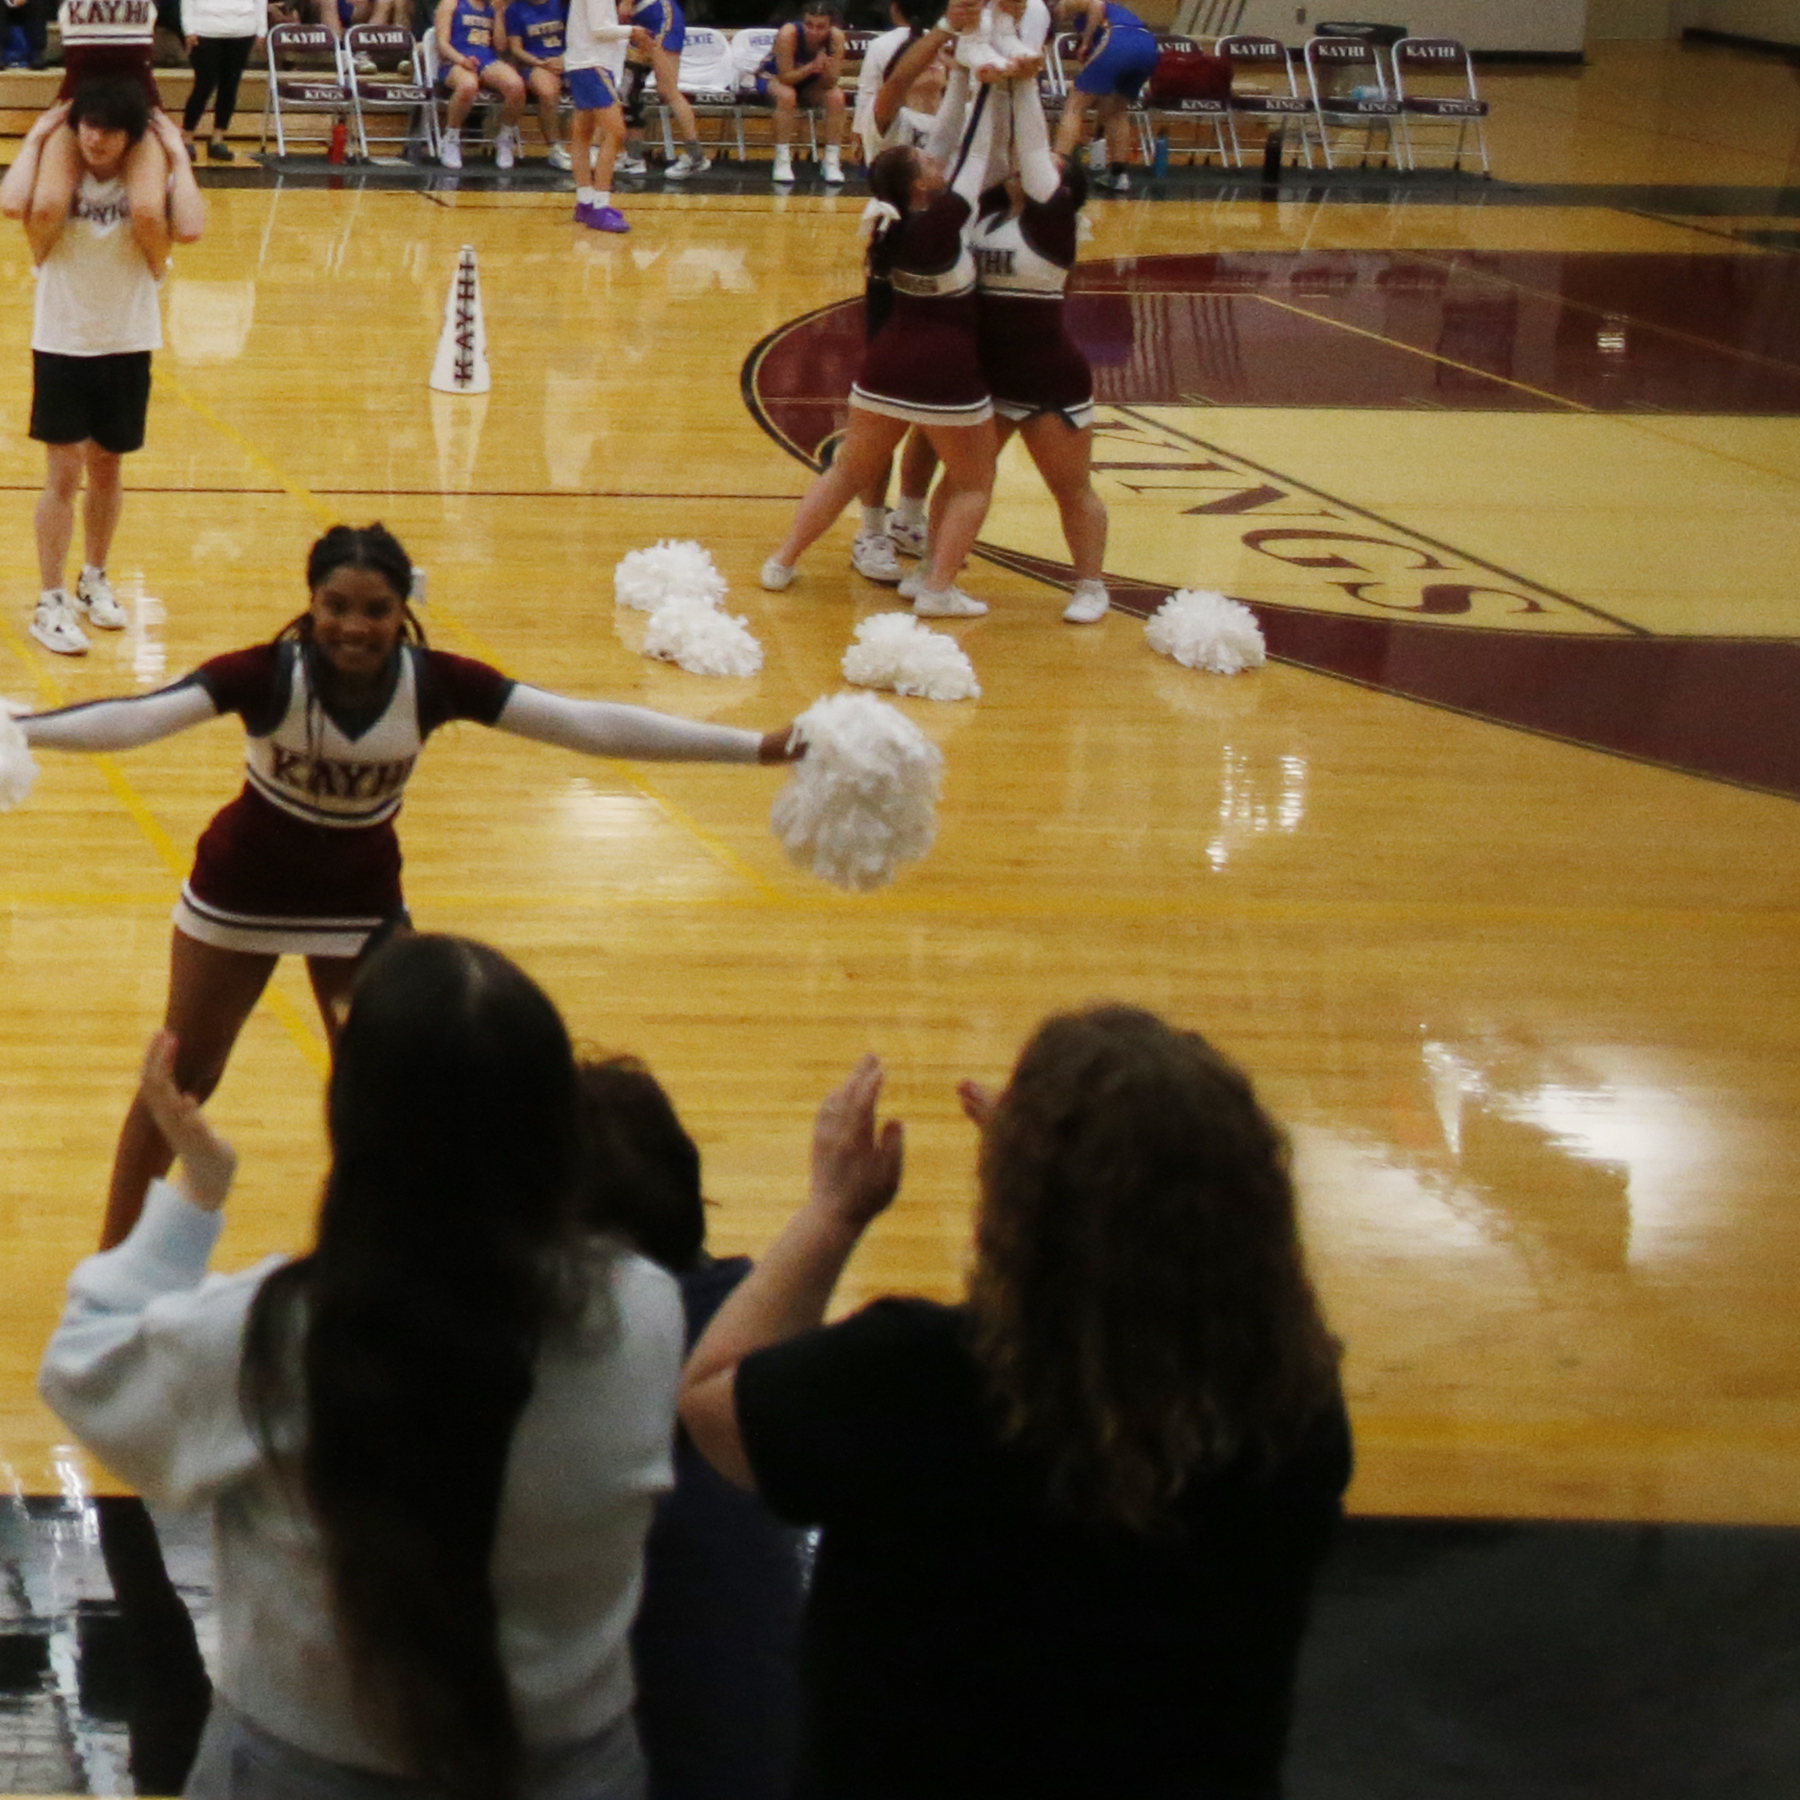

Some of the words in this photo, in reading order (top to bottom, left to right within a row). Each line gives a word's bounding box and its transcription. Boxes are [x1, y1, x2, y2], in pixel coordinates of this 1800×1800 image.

[69, 0, 149, 24] KAYHI
[280, 30, 326, 45] KAYHI
[358, 30, 404, 45] KAYHI
[1229, 43, 1277, 56] KAYHI
[1318, 43, 1365, 58] KAYHI
[1406, 45, 1456, 59] KAYHI
[304, 87, 345, 100] KINGS
[386, 87, 427, 100] KINGS
[1180, 99, 1222, 112] KINGS
[1265, 99, 1307, 112] KINGS
[1357, 101, 1399, 114] KINGS
[1438, 102, 1482, 115] KINGS
[454, 263, 475, 382] KAYHI
[1090, 418, 1555, 614] INGS
